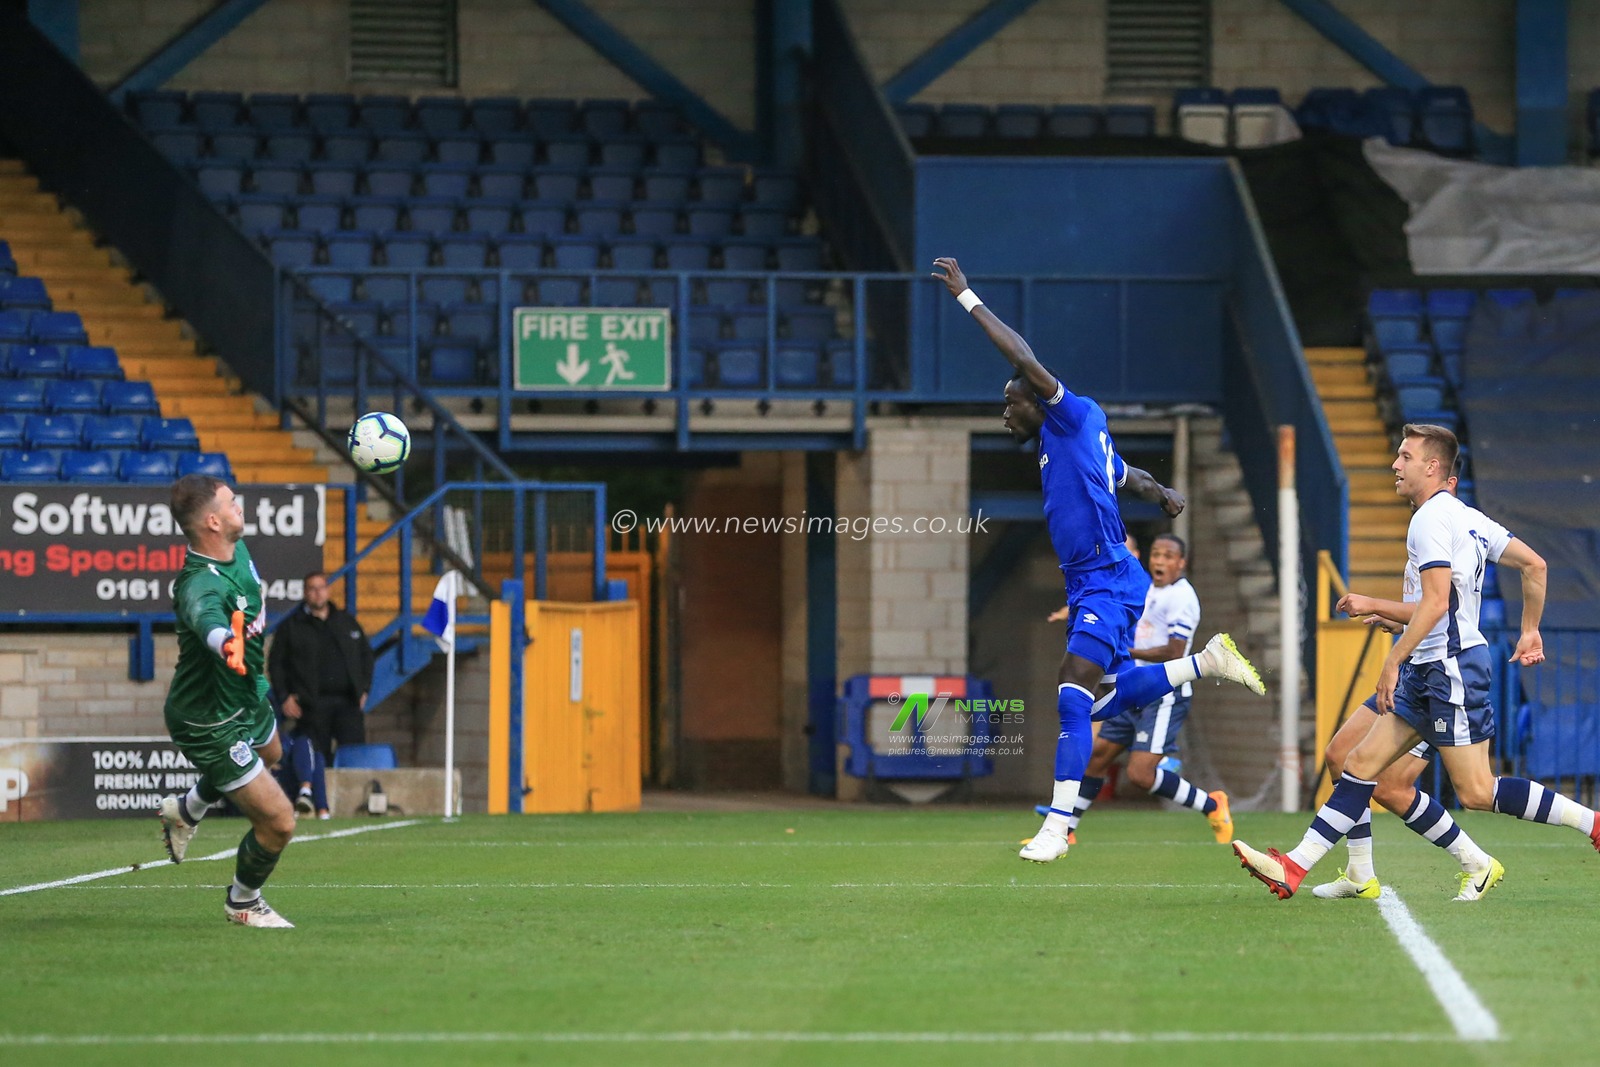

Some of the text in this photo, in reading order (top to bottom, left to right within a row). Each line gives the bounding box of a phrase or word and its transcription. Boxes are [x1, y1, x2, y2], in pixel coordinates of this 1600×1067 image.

[522, 315, 662, 340] FIRE EXIT
[12, 492, 186, 536] Softwa
[46, 544, 187, 577] Speciali
[96, 578, 160, 600] 0161
[92, 750, 200, 769] 100% ARA
[94, 774, 162, 790] FRESHLY
[96, 793, 163, 810] GROUND
